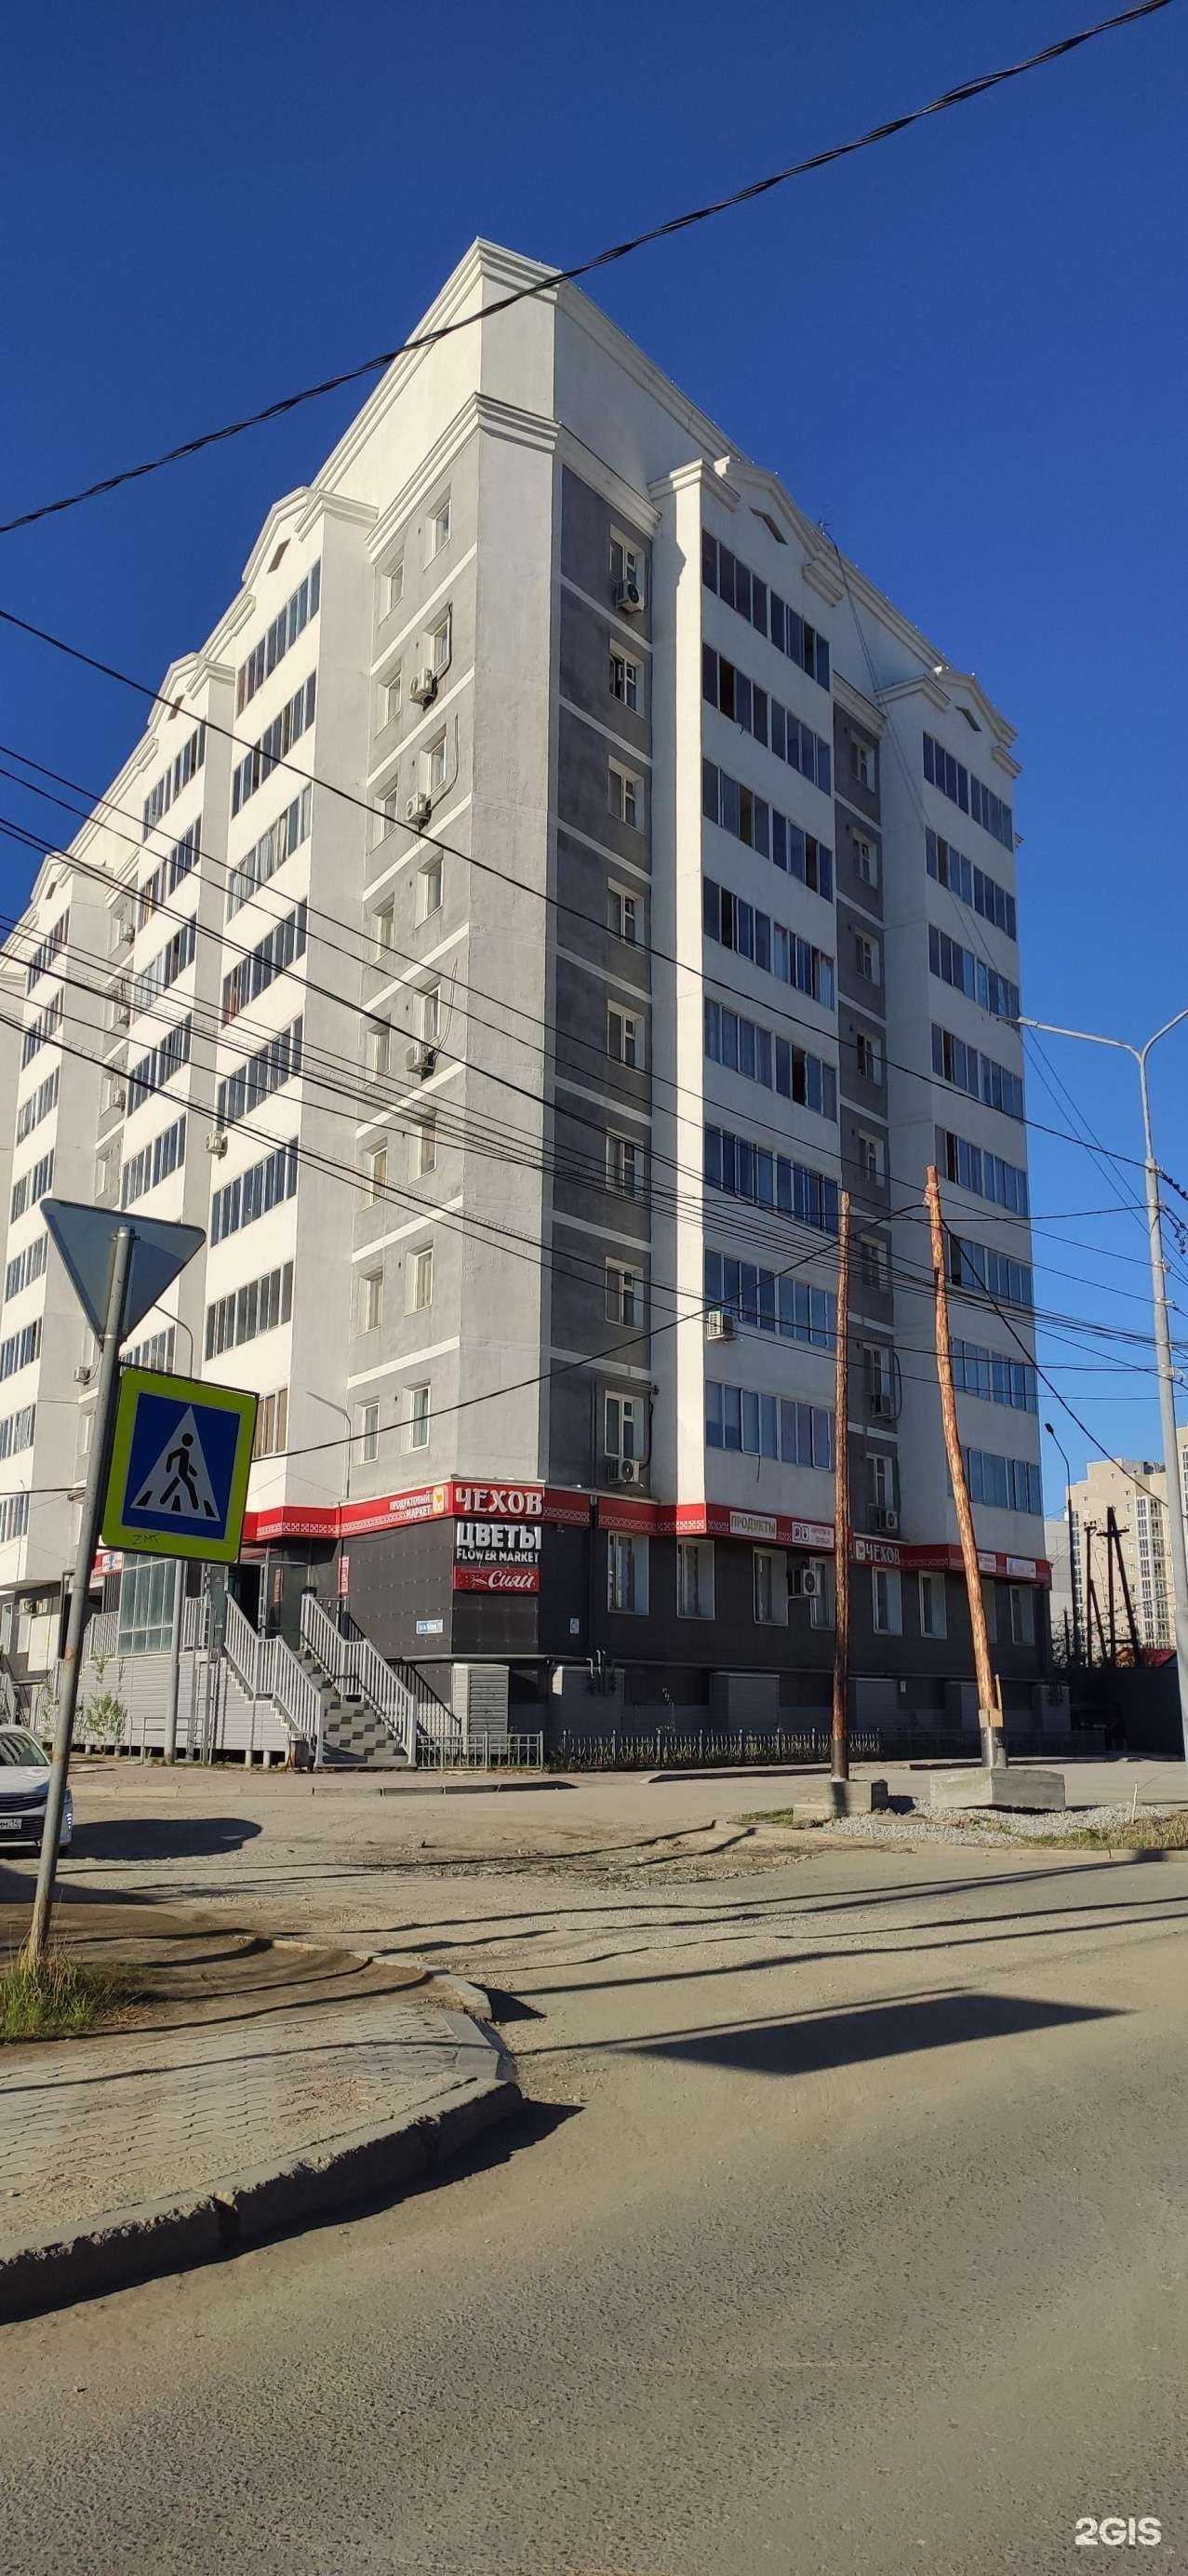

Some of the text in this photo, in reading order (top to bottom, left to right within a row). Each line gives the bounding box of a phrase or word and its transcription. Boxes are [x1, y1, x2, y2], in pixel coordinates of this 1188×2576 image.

[455, 1487, 542, 1515] ЧЕХОВ
[731, 1514, 776, 1535] ПРОДУКТЫ
[456, 1522, 542, 1550] ЦВЕТЫ
[456, 1548, 540, 1563] FLOWER MARKET
[866, 1542, 901, 1564] ЧЕХОВ
[487, 1570, 536, 1589] Сияй
